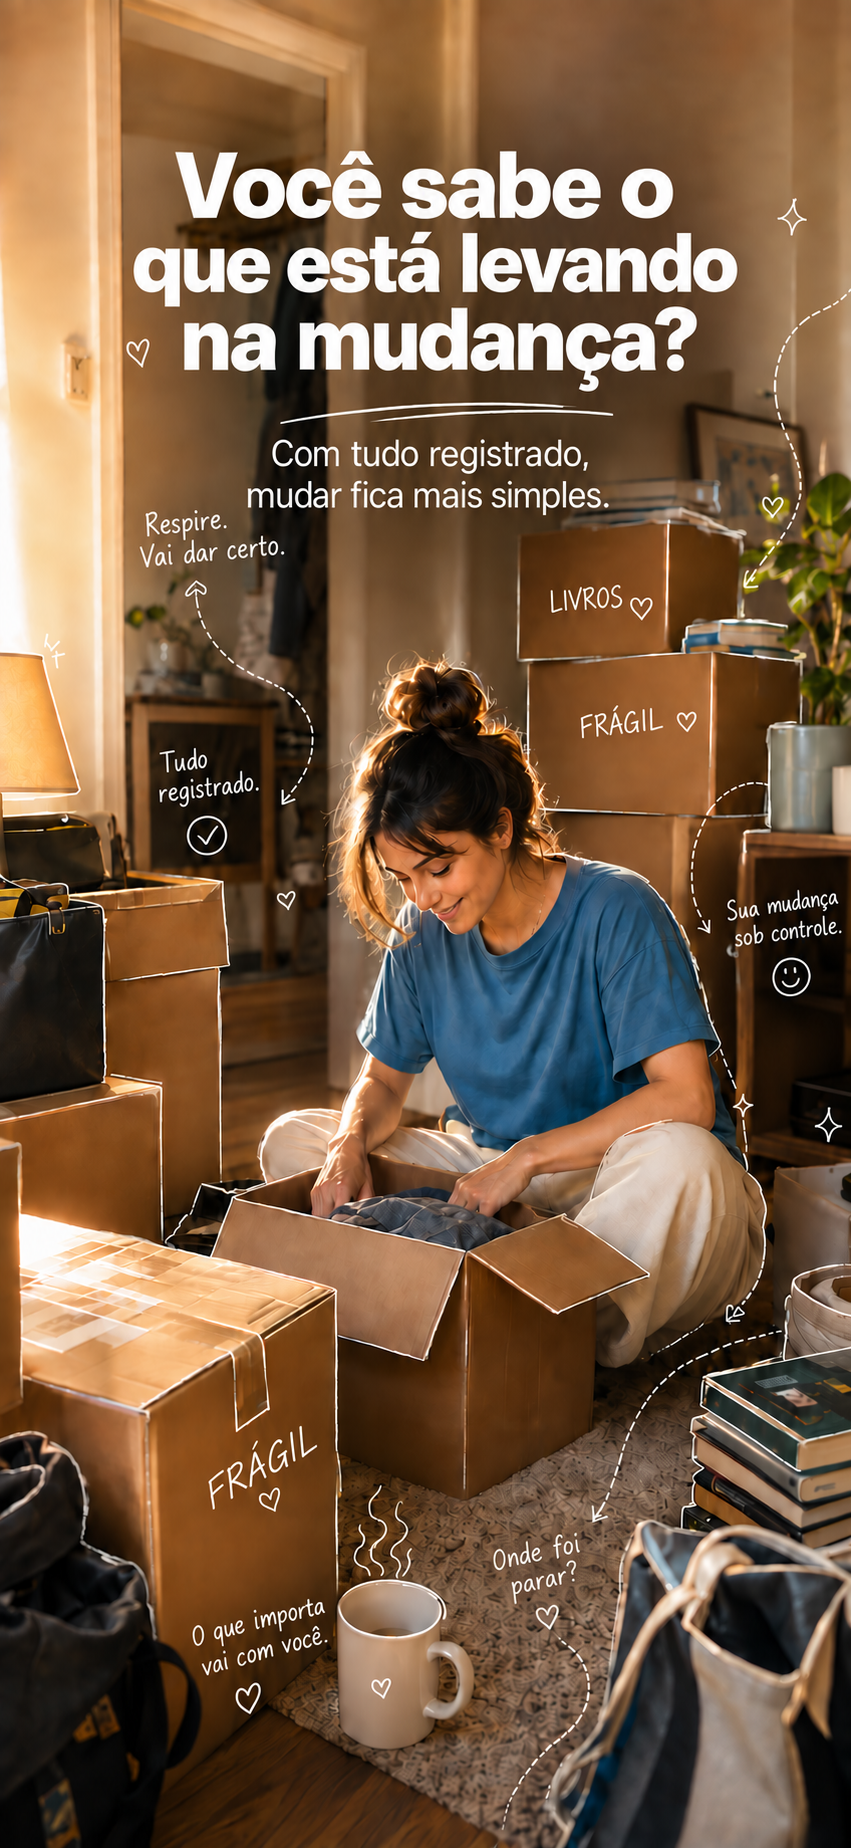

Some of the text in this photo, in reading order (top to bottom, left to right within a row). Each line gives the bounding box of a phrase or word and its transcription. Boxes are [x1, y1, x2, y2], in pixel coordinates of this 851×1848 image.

[551, 585, 622, 613] LIVROS
[581, 705, 663, 738] FRÁGIL
[209, 1426, 317, 1510] FRÁGIL
